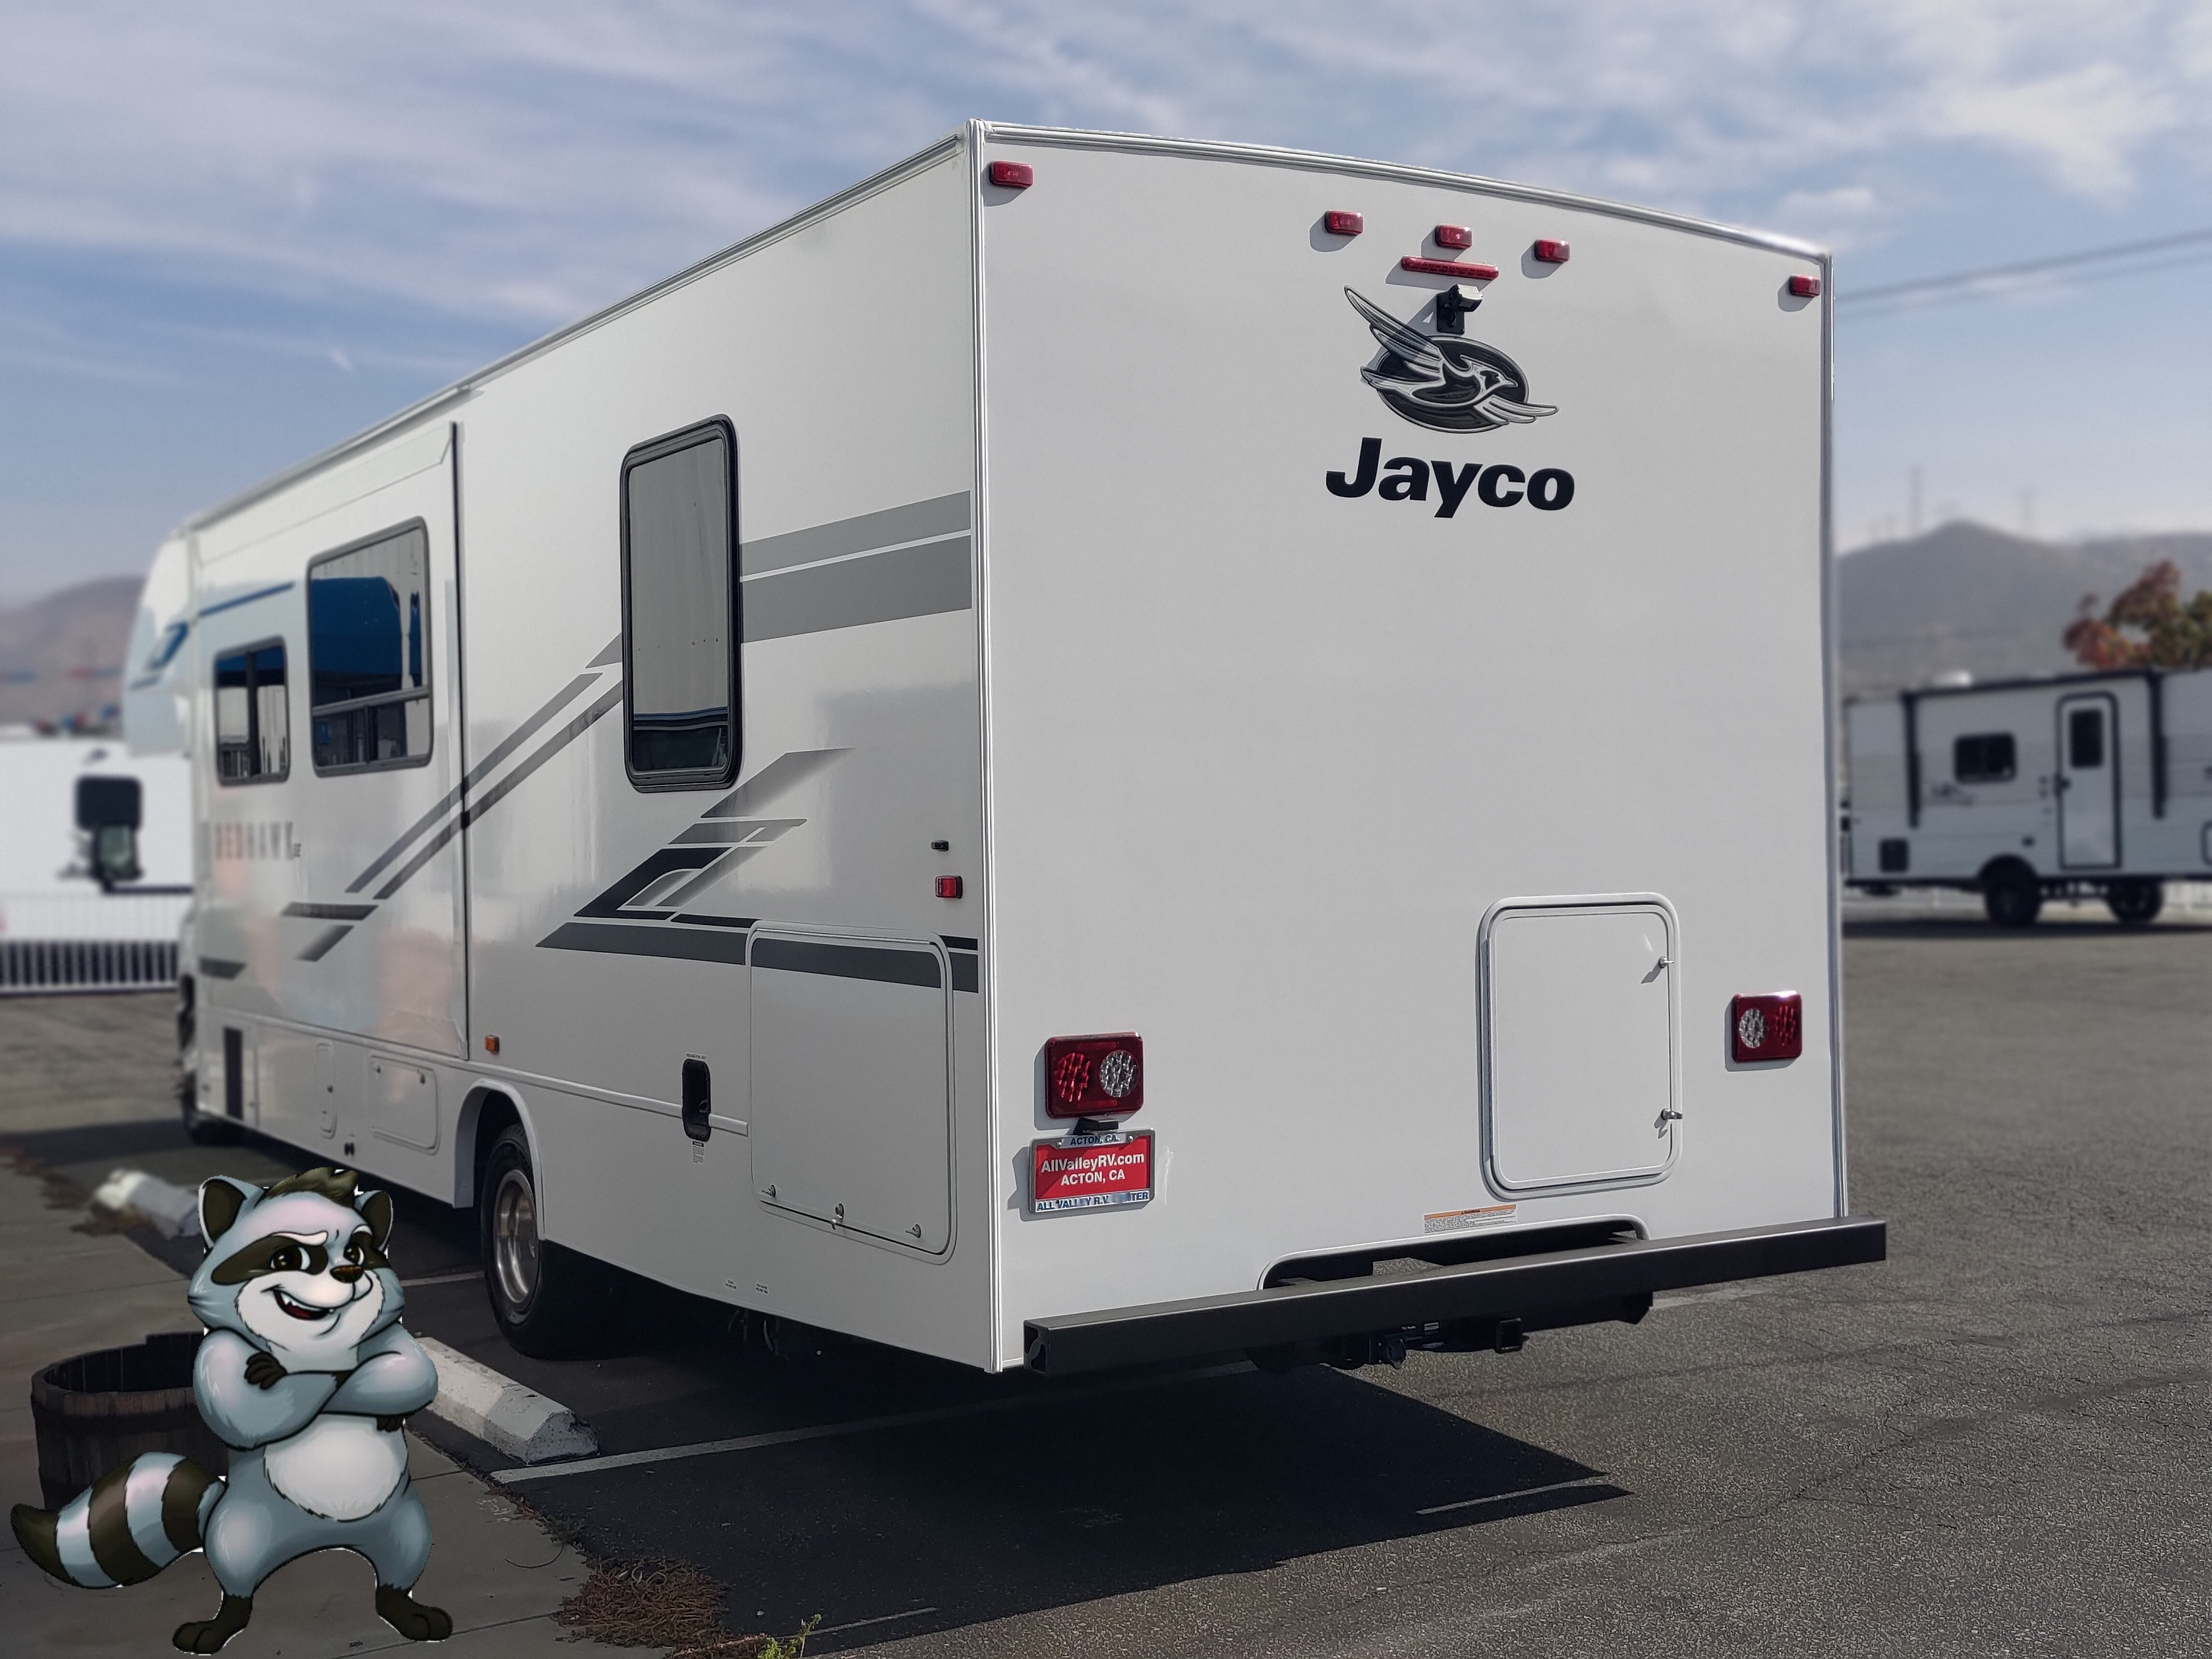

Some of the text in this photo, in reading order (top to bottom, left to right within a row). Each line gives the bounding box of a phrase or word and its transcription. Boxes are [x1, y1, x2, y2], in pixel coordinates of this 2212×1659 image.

[1326, 437, 1574, 518] Jayco
[1070, 1135, 1102, 1145] ACTON,
[1041, 1153, 1144, 1173] AllValleyRV.com
[1061, 1169, 1125, 1186] ACTON, CA
[1037, 1202, 1055, 1211] ALL
[1058, 1197, 1091, 1208] VALLY
